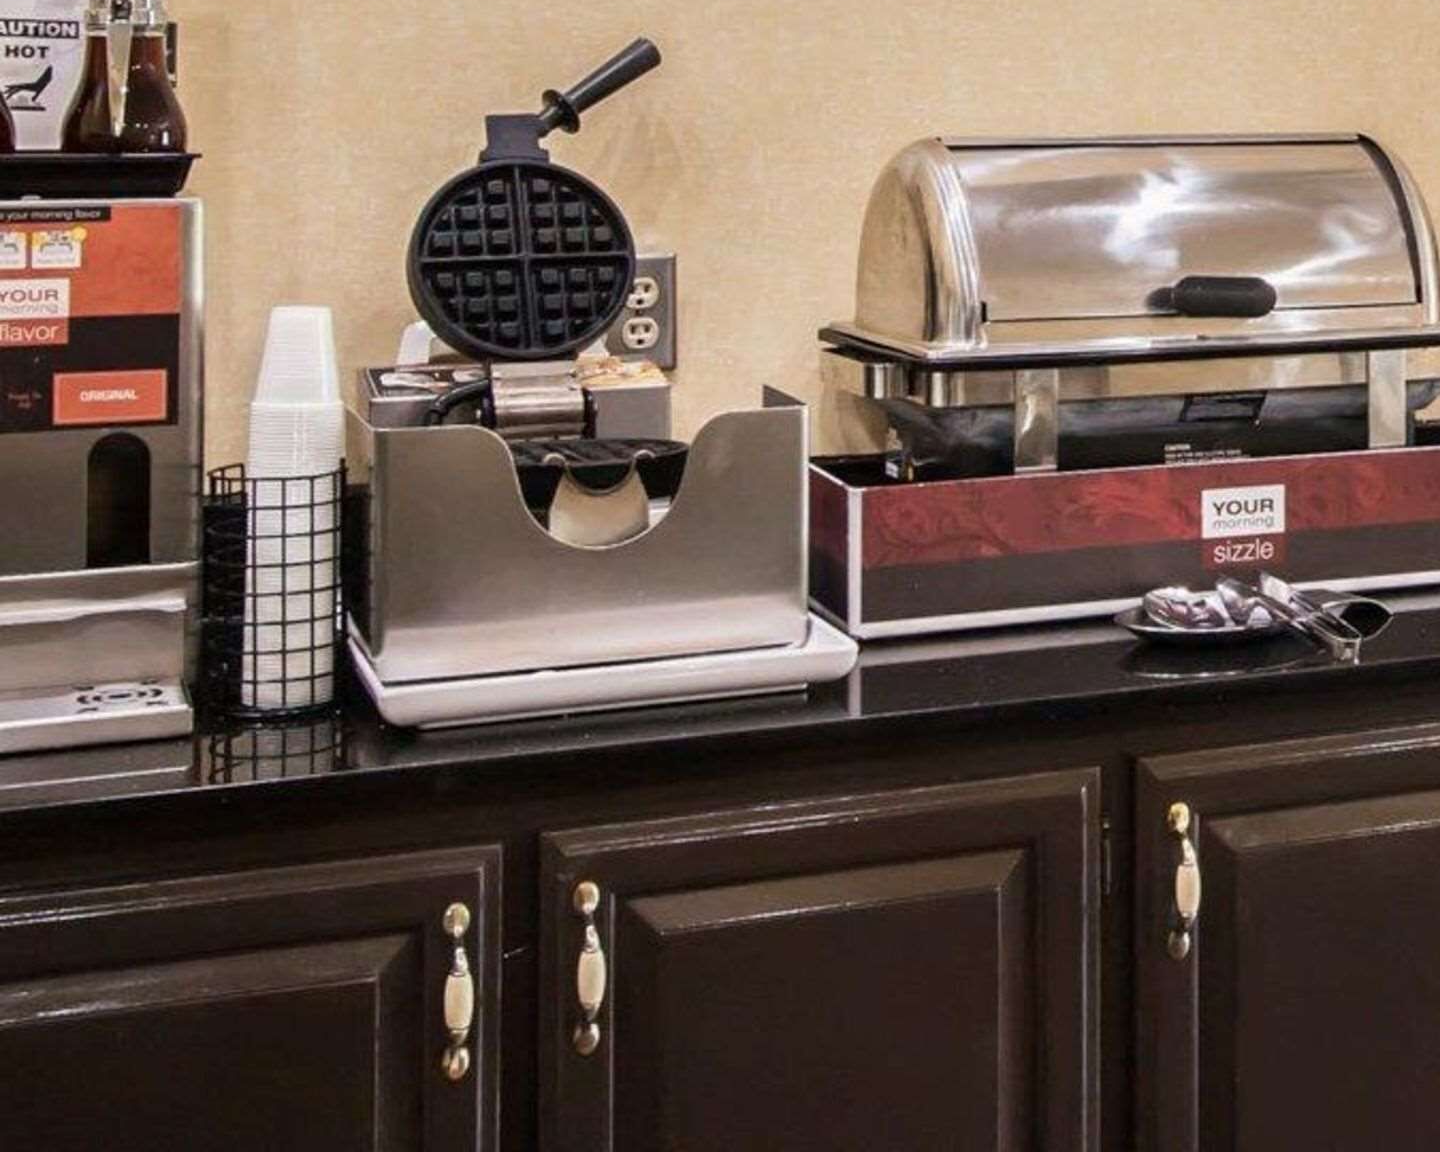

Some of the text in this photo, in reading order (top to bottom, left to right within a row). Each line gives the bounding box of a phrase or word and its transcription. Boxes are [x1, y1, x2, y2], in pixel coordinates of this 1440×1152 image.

[5, 44, 50, 59] HOT
[79, 388, 139, 402] ORIGINAL
[1212, 498, 1275, 516] YOUR
[1212, 515, 1275, 530] morning
[1213, 538, 1275, 564] sizzle
